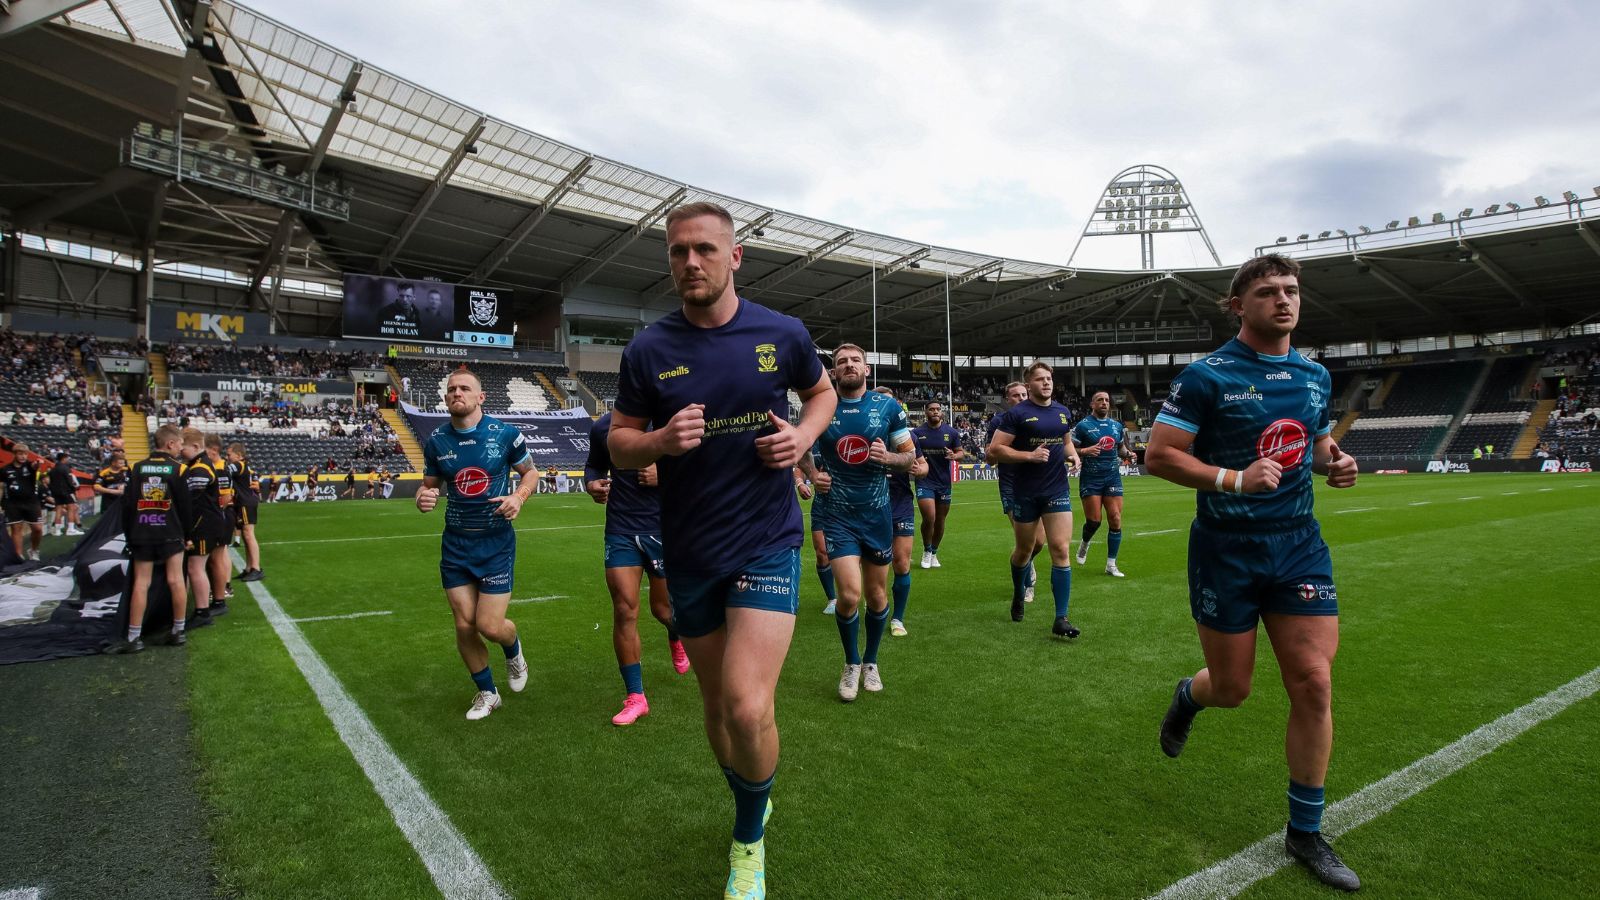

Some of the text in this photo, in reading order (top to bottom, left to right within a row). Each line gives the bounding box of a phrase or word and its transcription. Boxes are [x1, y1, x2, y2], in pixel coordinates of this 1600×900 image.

[176, 311, 245, 341] MKM
[471, 335, 477, 343] 0
[391, 344, 423, 353] UILDING
[436, 348, 468, 356] SUCCESS
[658, 365, 690, 380] oneills
[912, 361, 942, 380] MKM
[1265, 372, 1292, 380] oneills
[1223, 391, 1263, 402] Resulting
[704, 411, 769, 430] chwood Par
[729, 426, 746, 434] YOUR
[749, 575, 791, 584] University of
[749, 582, 791, 595] Chester
